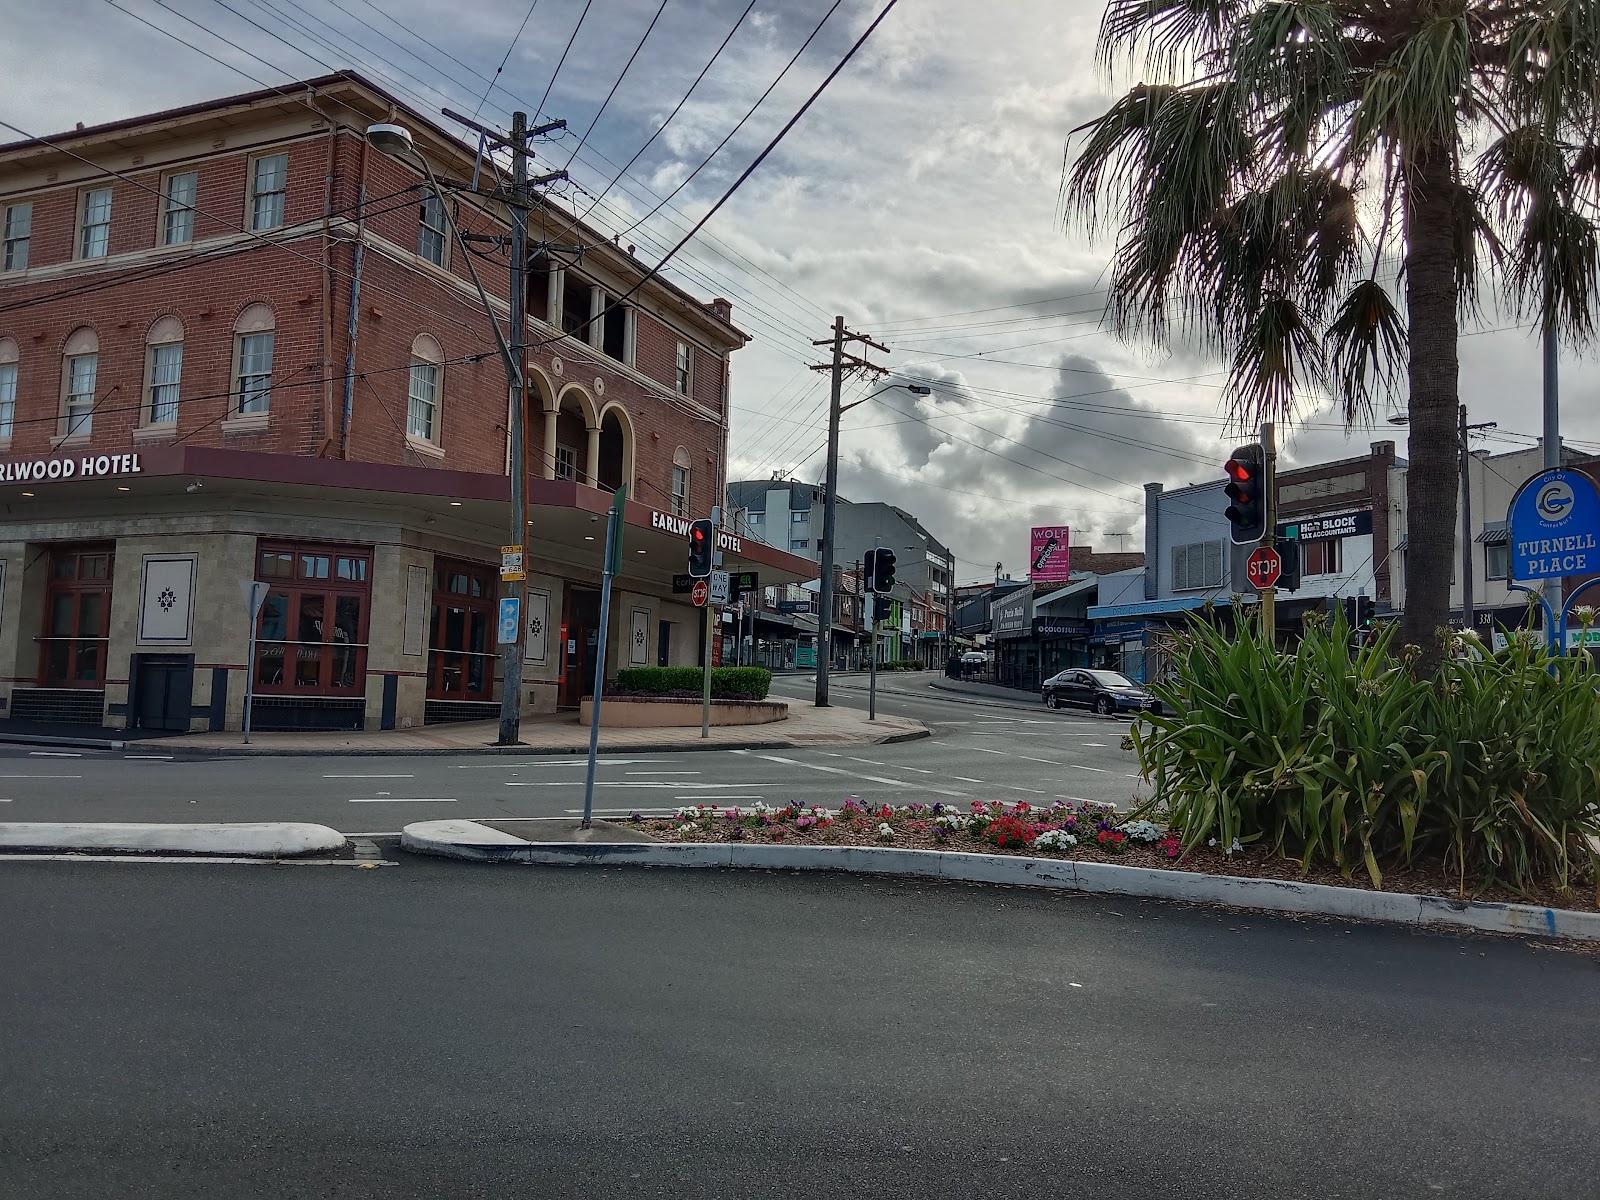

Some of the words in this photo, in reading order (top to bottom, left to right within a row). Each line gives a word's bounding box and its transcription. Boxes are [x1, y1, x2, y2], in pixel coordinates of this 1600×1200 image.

[81, 454, 141, 476] HOTEL
[1543, 475, 1555, 483] City
[652, 511, 689, 536] EARLW
[1322, 516, 1355, 529] BLOCK
[1033, 529, 1067, 539] WOLF
[1301, 532, 1312, 540] TAX
[1313, 526, 1356, 538] ACCOUNTANTS
[1053, 544, 1066, 552] ALE
[1518, 533, 1596, 557] TURNELL
[1250, 559, 1277, 576] STOP
[1528, 554, 1586, 575] PLACE
[713, 573, 727, 582] ONE
[694, 588, 706, 598] STOP
[712, 583, 727, 592] WAY
[1478, 613, 1491, 625] 338
[1044, 626, 1076, 634] COLOSSUS
